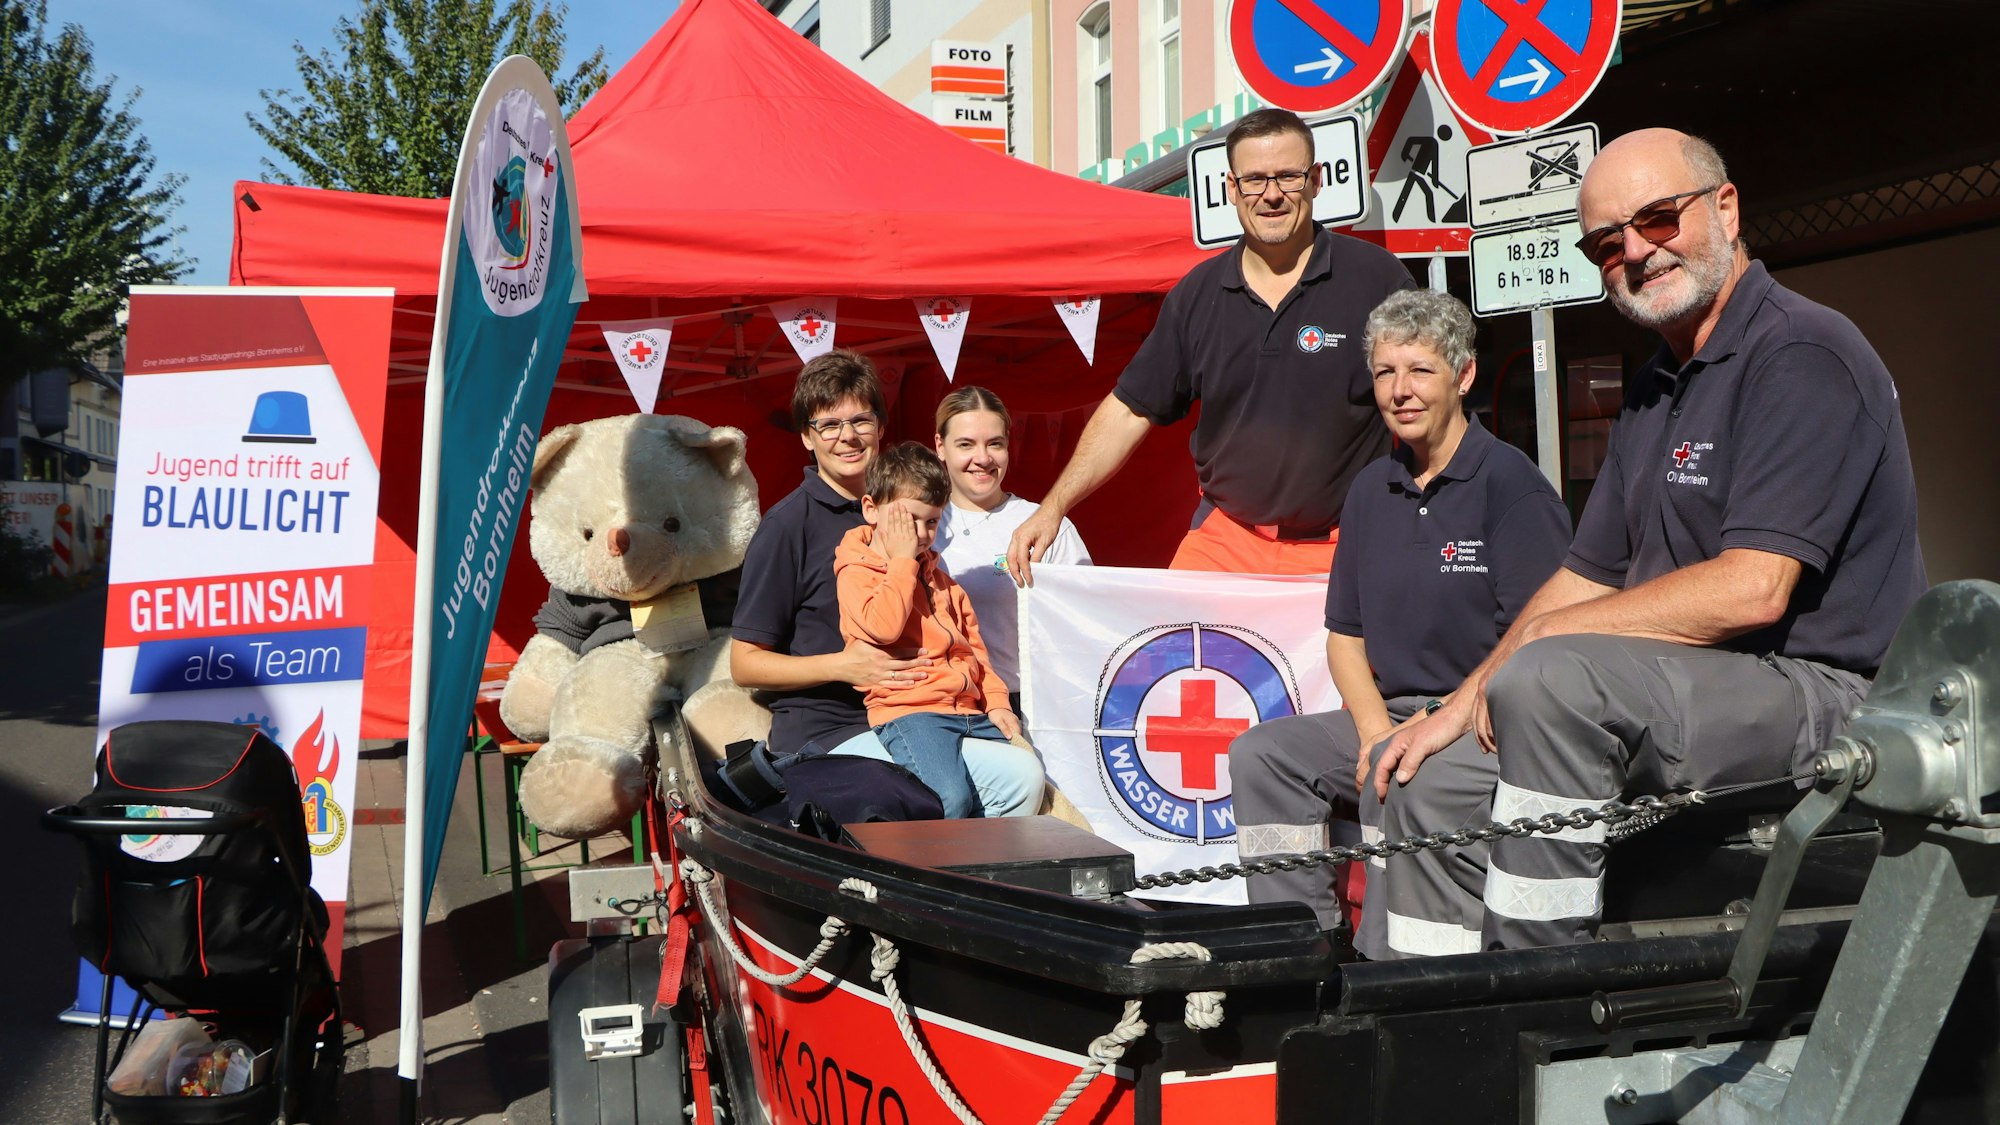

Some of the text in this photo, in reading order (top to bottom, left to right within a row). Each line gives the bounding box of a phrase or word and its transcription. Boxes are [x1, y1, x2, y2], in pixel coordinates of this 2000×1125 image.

[949, 48, 992, 62] FOTO
[955, 108, 993, 122] FILM
[484, 196, 550, 304] Jugendrotkreuz
[1507, 241, 1559, 262] 18.9.23
[1498, 272, 1506, 288] 6
[1512, 272, 1520, 287] h
[1539, 268, 1554, 285] 18
[1560, 267, 1569, 283] h
[143, 359, 157, 367] Eine
[147, 452, 350, 481] Jugend trifft auf
[142, 485, 350, 533] BLAULICHT
[472, 422, 535, 611] Bornheim
[1452, 564, 1489, 573] Bornheim
[130, 575, 343, 632] GEMEINSAM
[184, 642, 341, 682] als Team
[1110, 744, 1190, 829] WASSER
